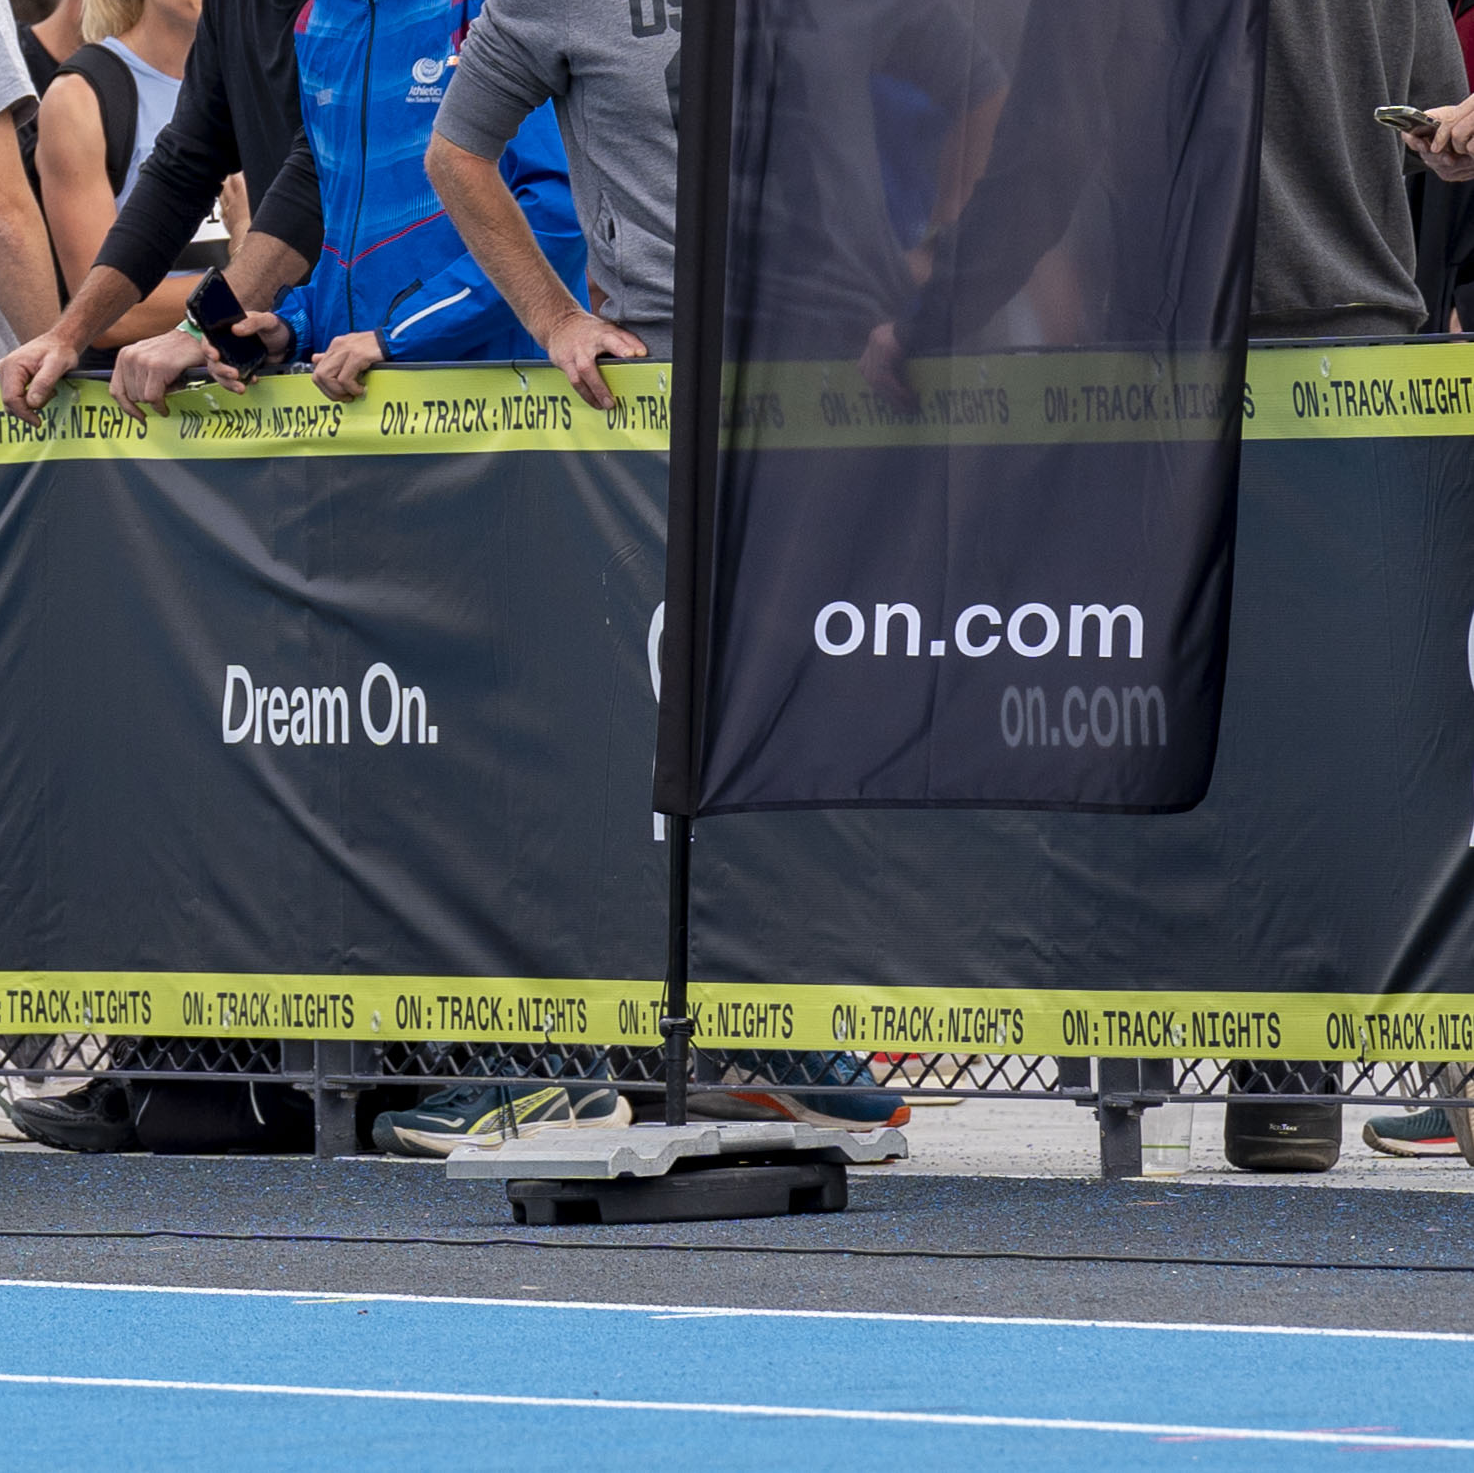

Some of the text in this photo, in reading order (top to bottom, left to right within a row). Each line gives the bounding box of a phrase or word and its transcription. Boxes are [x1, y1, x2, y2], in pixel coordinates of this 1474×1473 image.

[380, 395, 572, 435] ON:TRACK:NIGHTS
[1045, 382, 1255, 424] ON:TRACK:NIGS
[1292, 377, 1473, 418] ON:TRACK:NIGHT
[180, 404, 344, 439] ON:TRACK:NIGHTS
[813, 600, 1144, 659] on.com
[222, 661, 439, 746] Dream On.
[1000, 684, 1168, 748] on.com
[183, 992, 355, 1029] ON:TRACK:NIGHTS
[396, 994, 588, 1034] ON:TRACK:NIGHTS
[619, 999, 794, 1039] ON:TK:NIGHTS
[832, 1004, 1024, 1045] ON:TRACK:NIGHTS
[1063, 1008, 1282, 1049] ON:TRACK:NIGHTS
